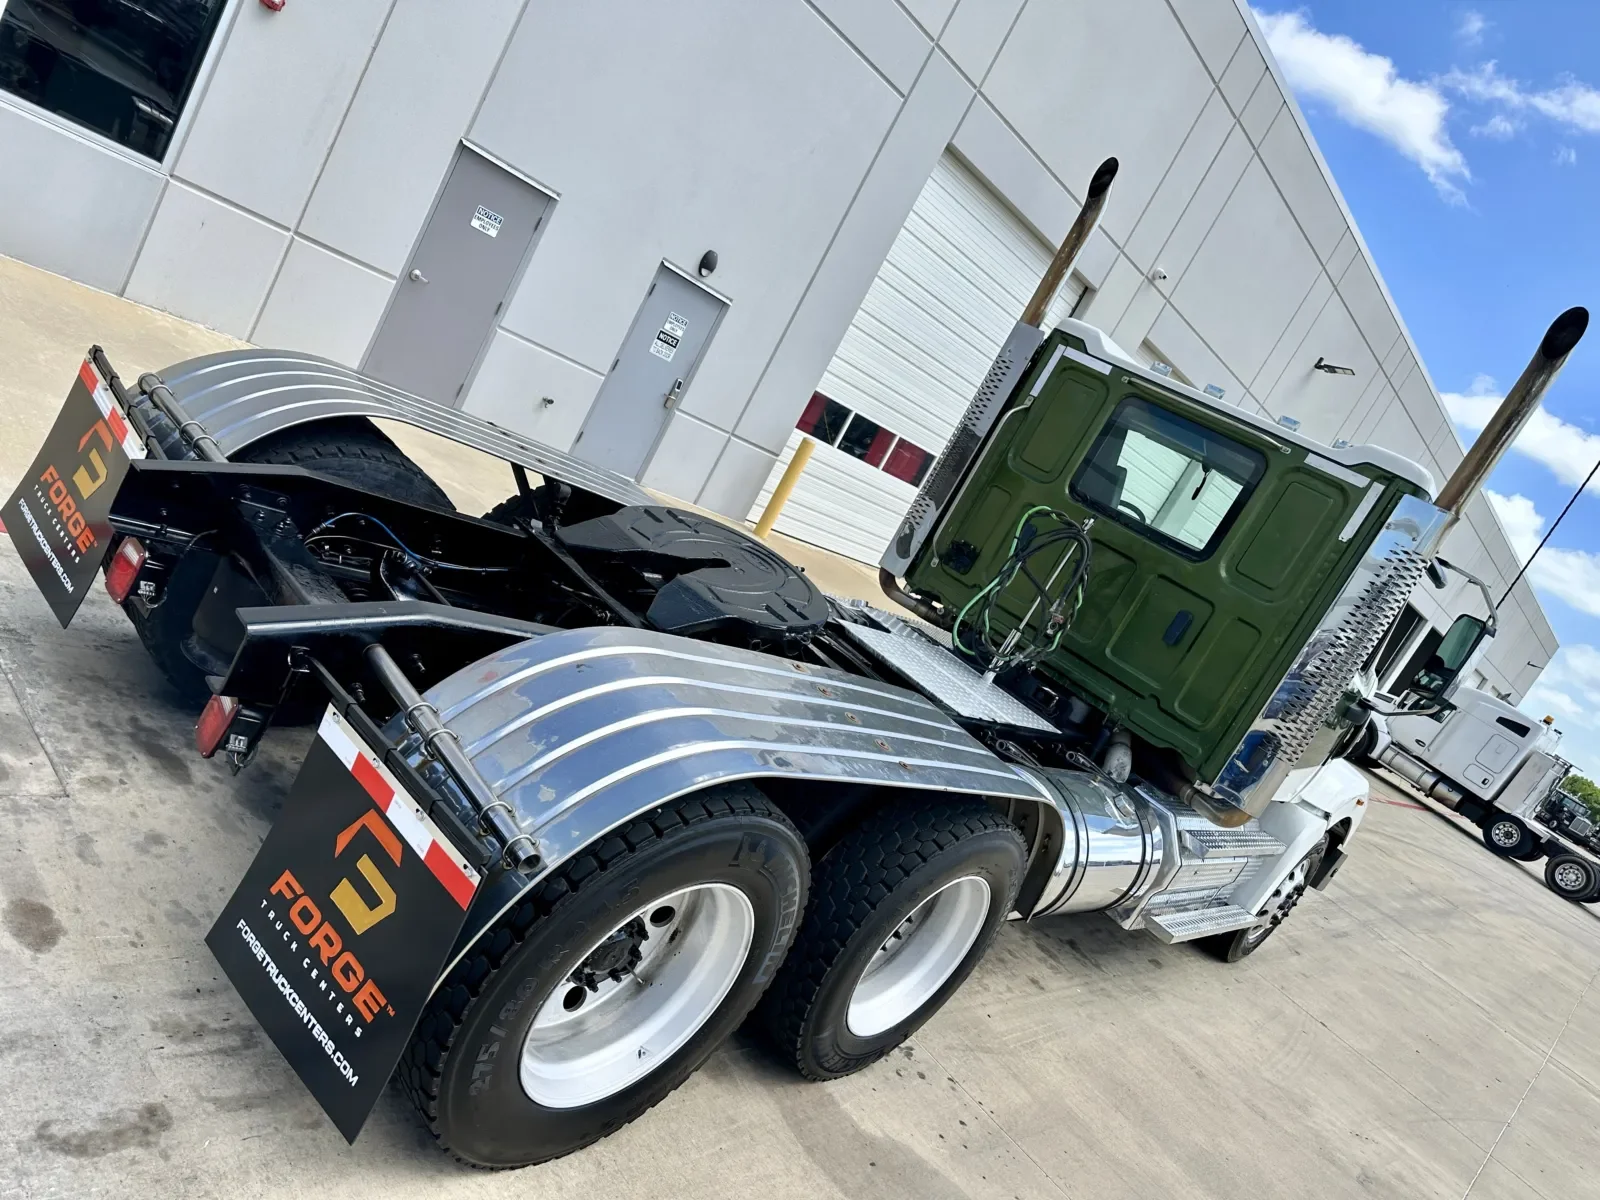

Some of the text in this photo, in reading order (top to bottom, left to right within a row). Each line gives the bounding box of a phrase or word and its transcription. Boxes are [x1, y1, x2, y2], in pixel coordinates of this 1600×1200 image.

[474, 214, 499, 230] EMPLOYEES
[478, 207, 502, 225] NOTICE
[479, 223, 490, 232] ONLY
[658, 332, 678, 346] NOTICE
[670, 313, 688, 326] NOTICE
[18, 498, 75, 594] FORGETRUCKCENTERS.COM
[34, 484, 80, 564] TRUCK CENTERS
[40, 464, 95, 554] FORGE
[260, 899, 363, 1038] TRUCK CENTERS
[269, 869, 387, 1024] FORGE
[236, 918, 359, 1087] FORGETRUCKCENTERS.COM
